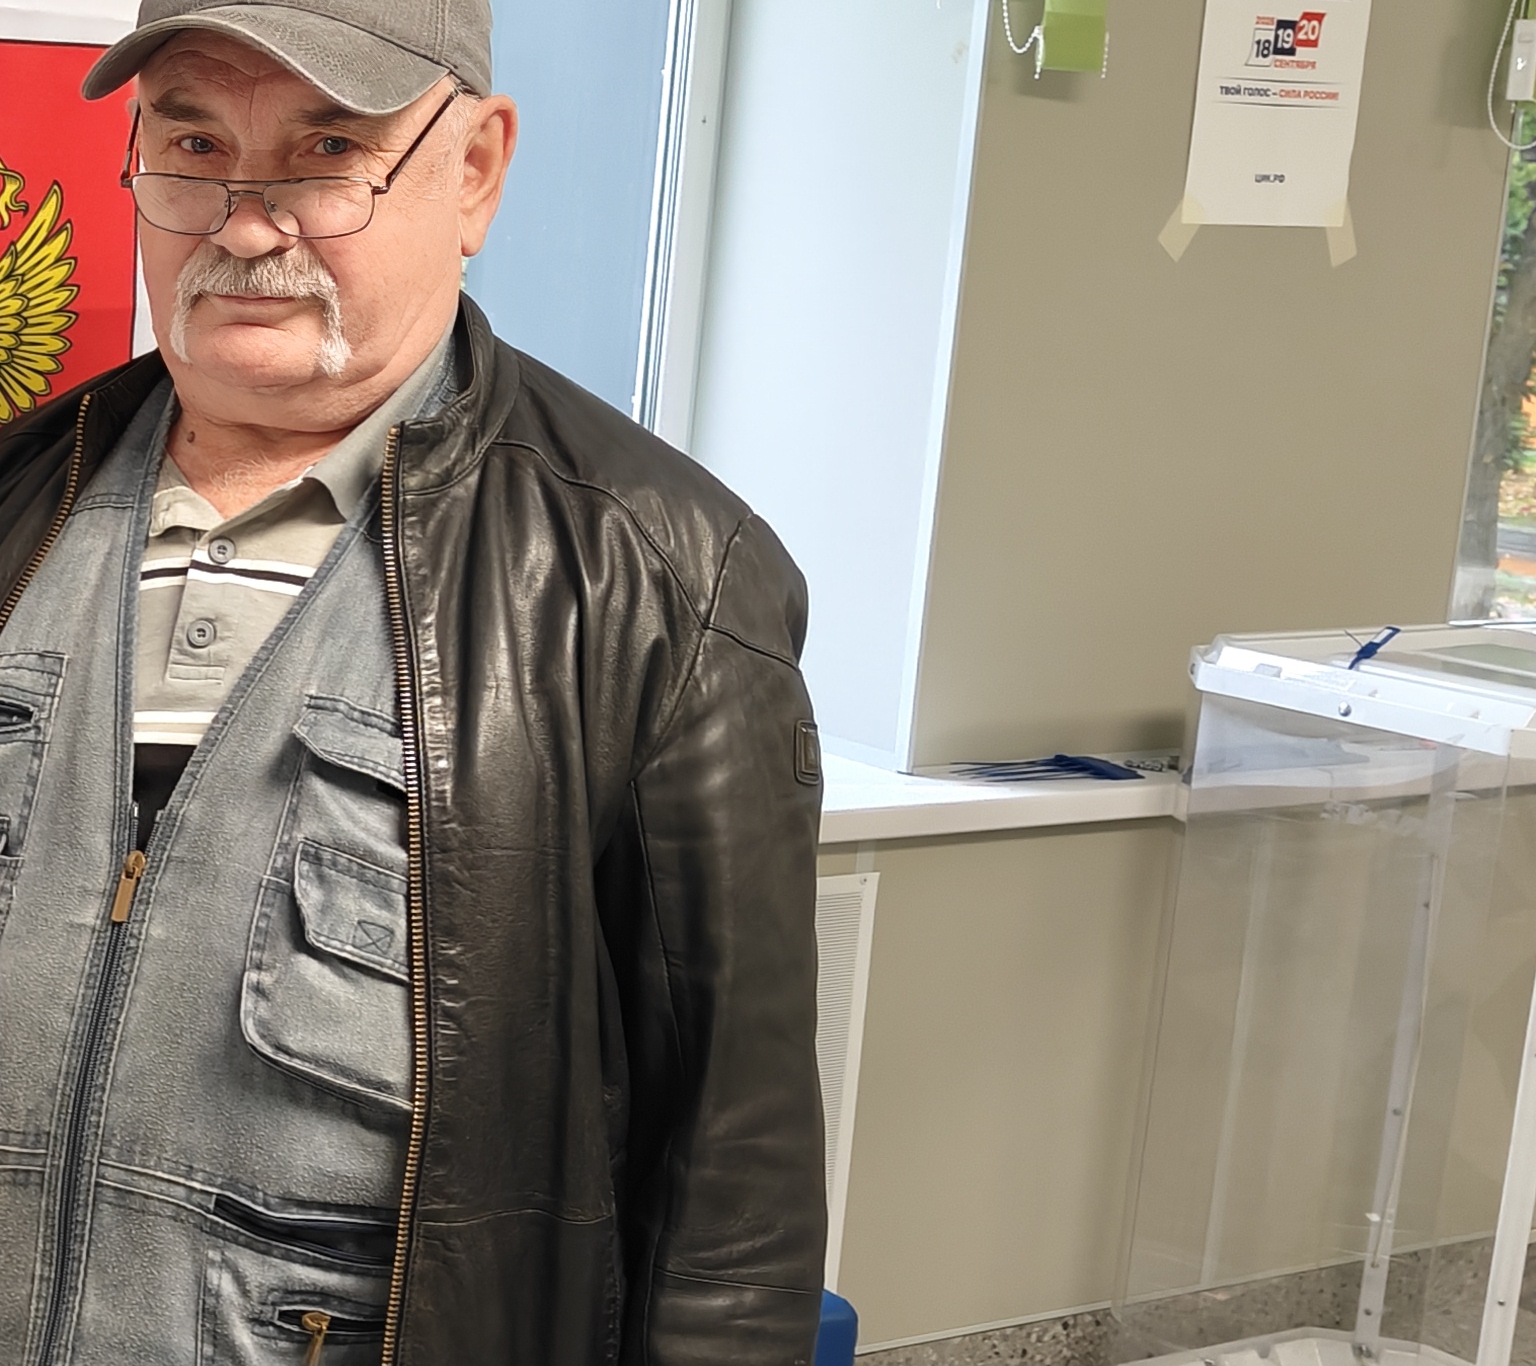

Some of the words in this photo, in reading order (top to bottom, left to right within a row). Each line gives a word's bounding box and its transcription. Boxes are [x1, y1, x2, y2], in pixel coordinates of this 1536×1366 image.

[1254, 38, 1272, 59] 18
[1277, 28, 1294, 49] 19
[1297, 20, 1320, 41] 20
[1220, 84, 1242, 96] ТВОЙ
[1243, 87, 1271, 98] ГОЛОС
